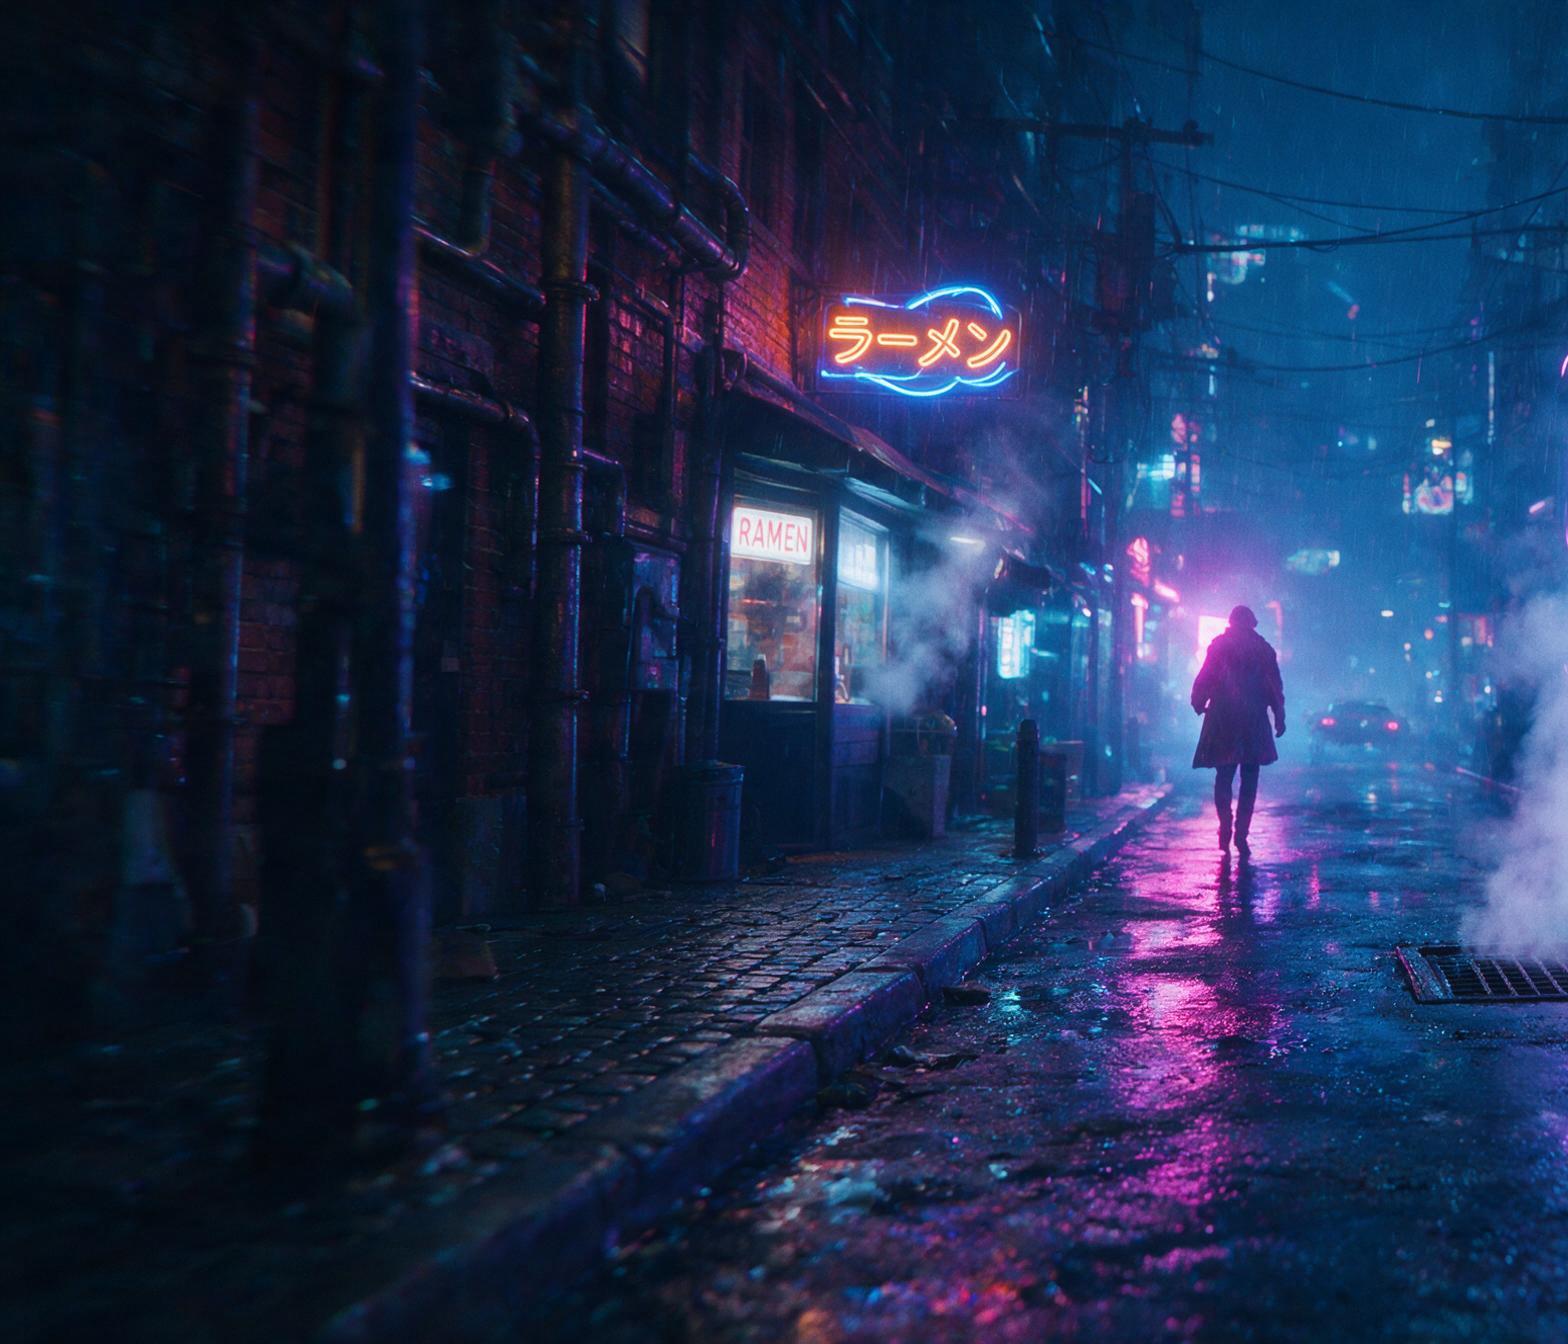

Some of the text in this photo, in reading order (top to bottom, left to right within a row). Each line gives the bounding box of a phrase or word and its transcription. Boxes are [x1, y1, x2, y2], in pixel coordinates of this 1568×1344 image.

[828, 315, 1012, 369] ラーメン
[738, 515, 809, 553] RAMEN
